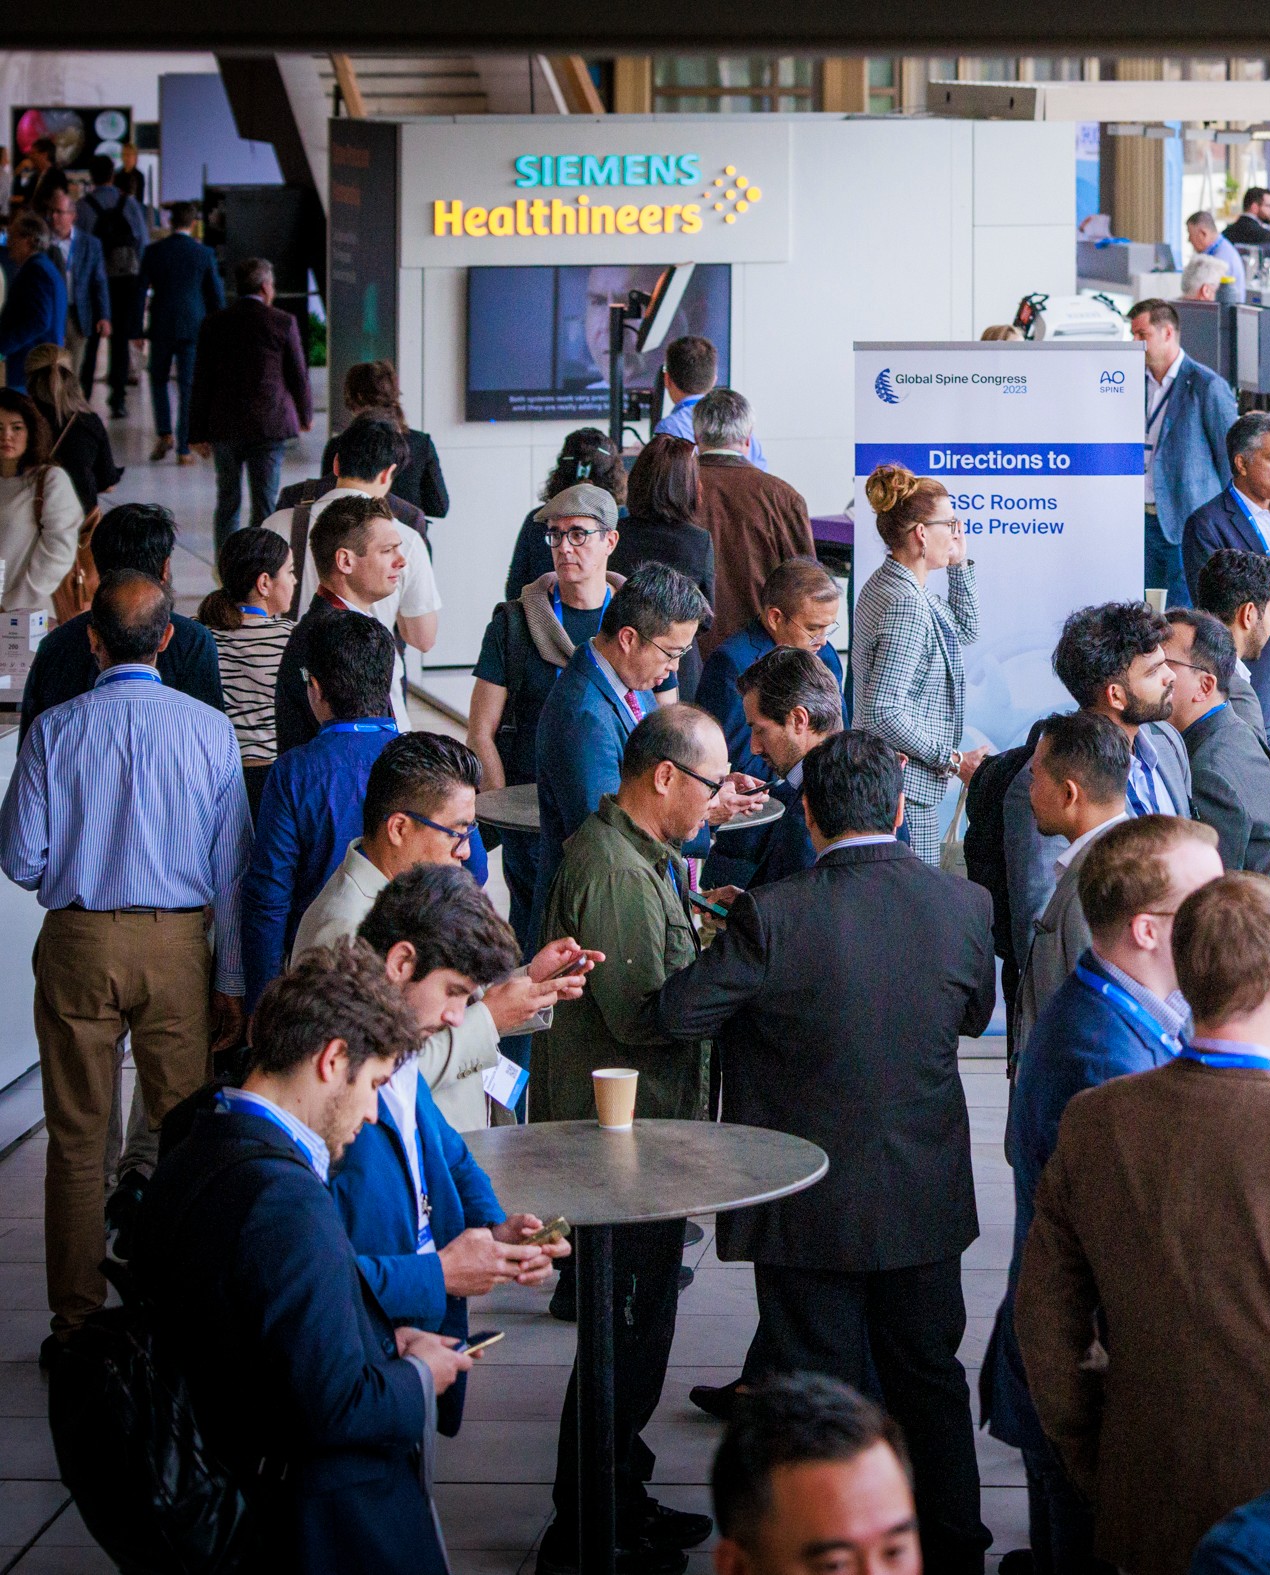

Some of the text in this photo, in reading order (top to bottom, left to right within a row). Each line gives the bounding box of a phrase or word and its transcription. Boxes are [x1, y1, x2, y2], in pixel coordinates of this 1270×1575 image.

[514, 153, 702, 188] SIEMENS
[433, 194, 703, 237] Healthineers
[895, 373, 1027, 387] Global Spine Congress
[1100, 370, 1125, 385] AO
[1003, 385, 1027, 394] 2023
[1100, 386, 1124, 394] SPINE
[929, 450, 1071, 470] Directions to
[991, 494, 1058, 510] Rooms
[963, 518, 1065, 535] de Preview
